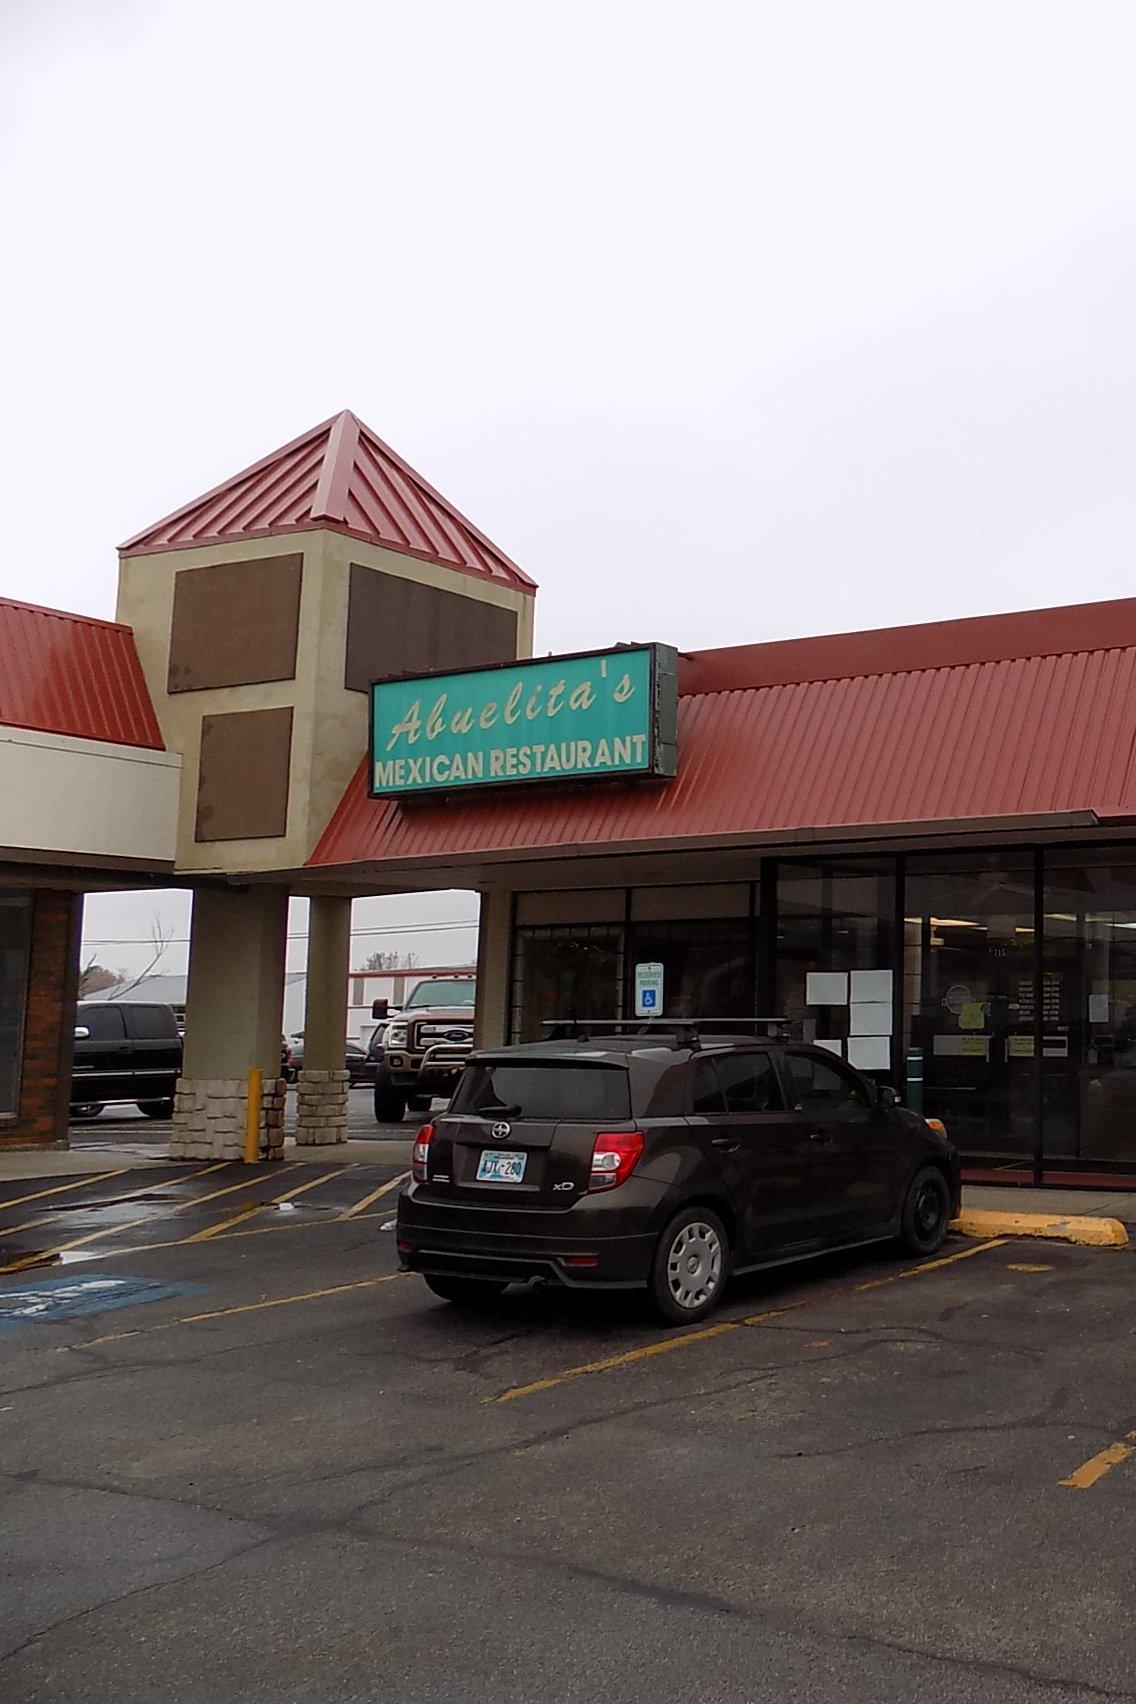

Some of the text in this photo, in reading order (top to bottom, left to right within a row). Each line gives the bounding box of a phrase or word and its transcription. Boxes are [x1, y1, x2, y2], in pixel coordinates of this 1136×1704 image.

[386, 659, 635, 751] Abuelita's
[374, 734, 646, 788] MEXICAN RESTAURANT
